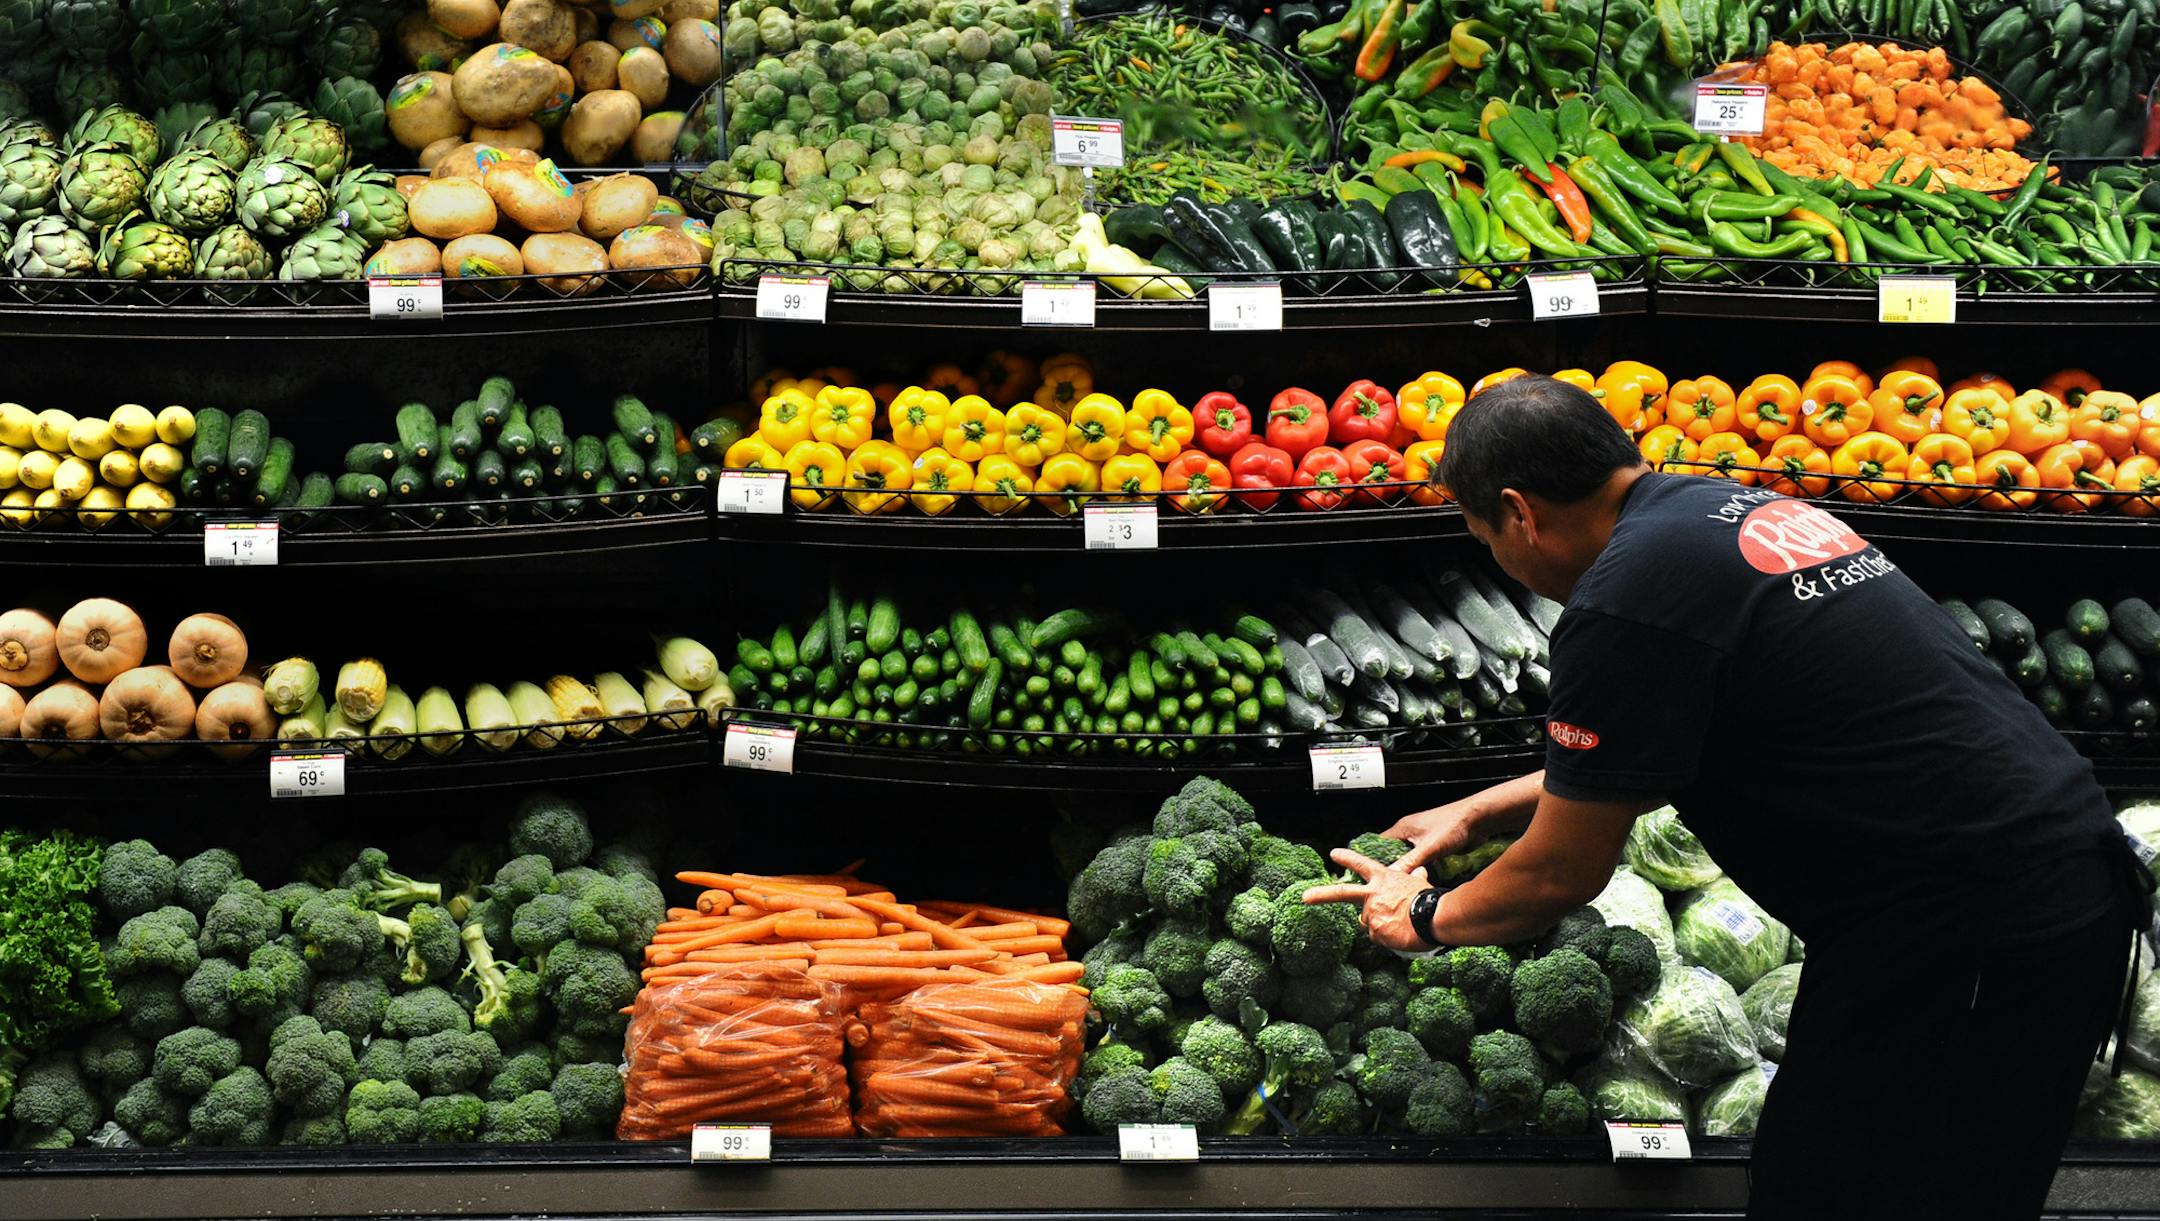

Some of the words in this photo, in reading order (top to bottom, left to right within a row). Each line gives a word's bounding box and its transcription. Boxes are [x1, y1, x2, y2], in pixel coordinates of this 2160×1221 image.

[1720, 106, 1737, 119] 25
[1078, 140, 1087, 153] 6
[397, 298, 415, 312] 99
[784, 294, 801, 309] 99
[1050, 300, 1055, 313] 1
[1906, 297, 1912, 311] 1
[1236, 304, 1242, 319] 1
[744, 488, 750, 503] 1
[1109, 525, 1114, 533] 2
[232, 541, 237, 555] 1
[242, 540, 253, 548] 49
[1791, 573, 1824, 601] &
[1820, 559, 1874, 591] Fast
[1551, 721, 1593, 747] Ralphs
[749, 745, 766, 761] 99
[299, 771, 317, 786] 69
[1338, 765, 1347, 780] 2
[723, 1136, 743, 1150] 99
[1149, 1136, 1156, 1149] 1
[1641, 1136, 1661, 1150] 99
